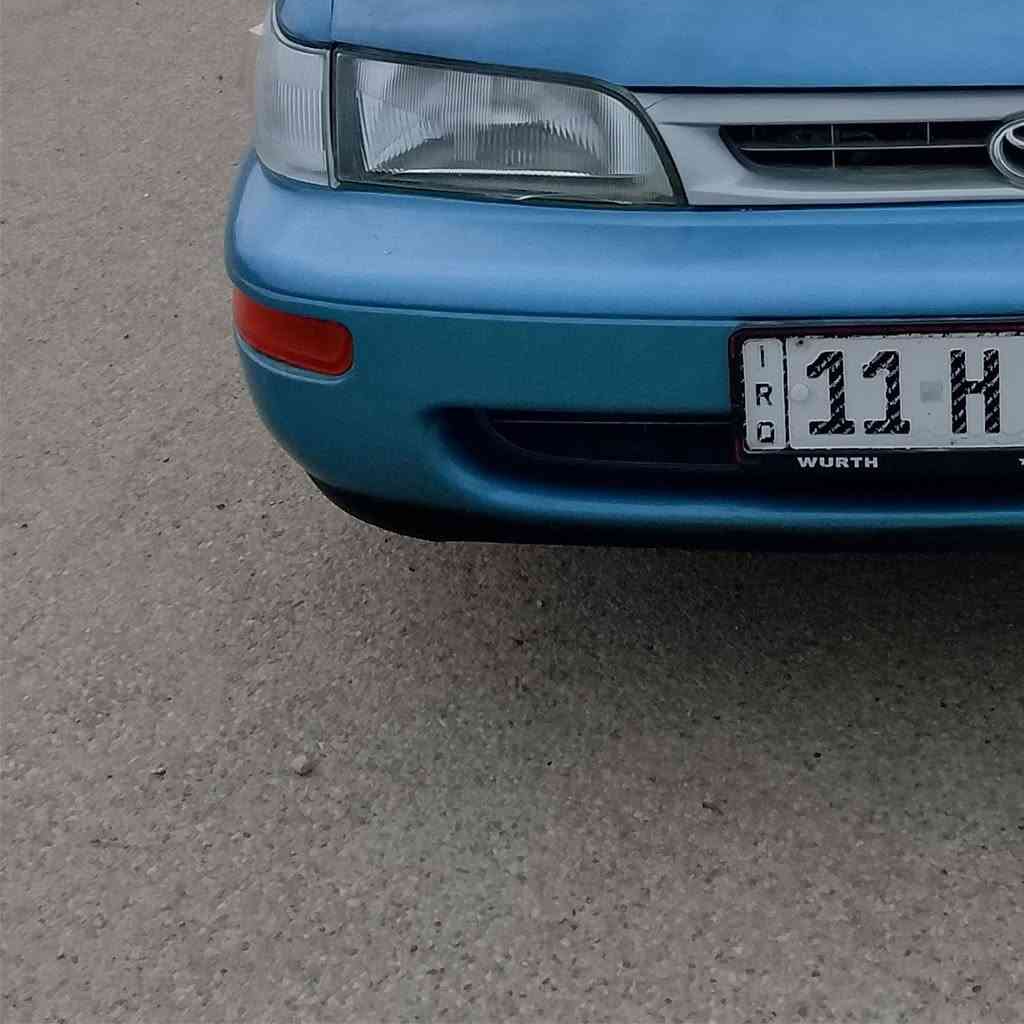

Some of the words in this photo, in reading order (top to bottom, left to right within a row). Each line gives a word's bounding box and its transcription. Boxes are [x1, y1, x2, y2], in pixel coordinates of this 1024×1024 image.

[806, 351, 911, 435] 11
[950, 349, 1001, 434] H
[797, 456, 879, 469] WURTH
